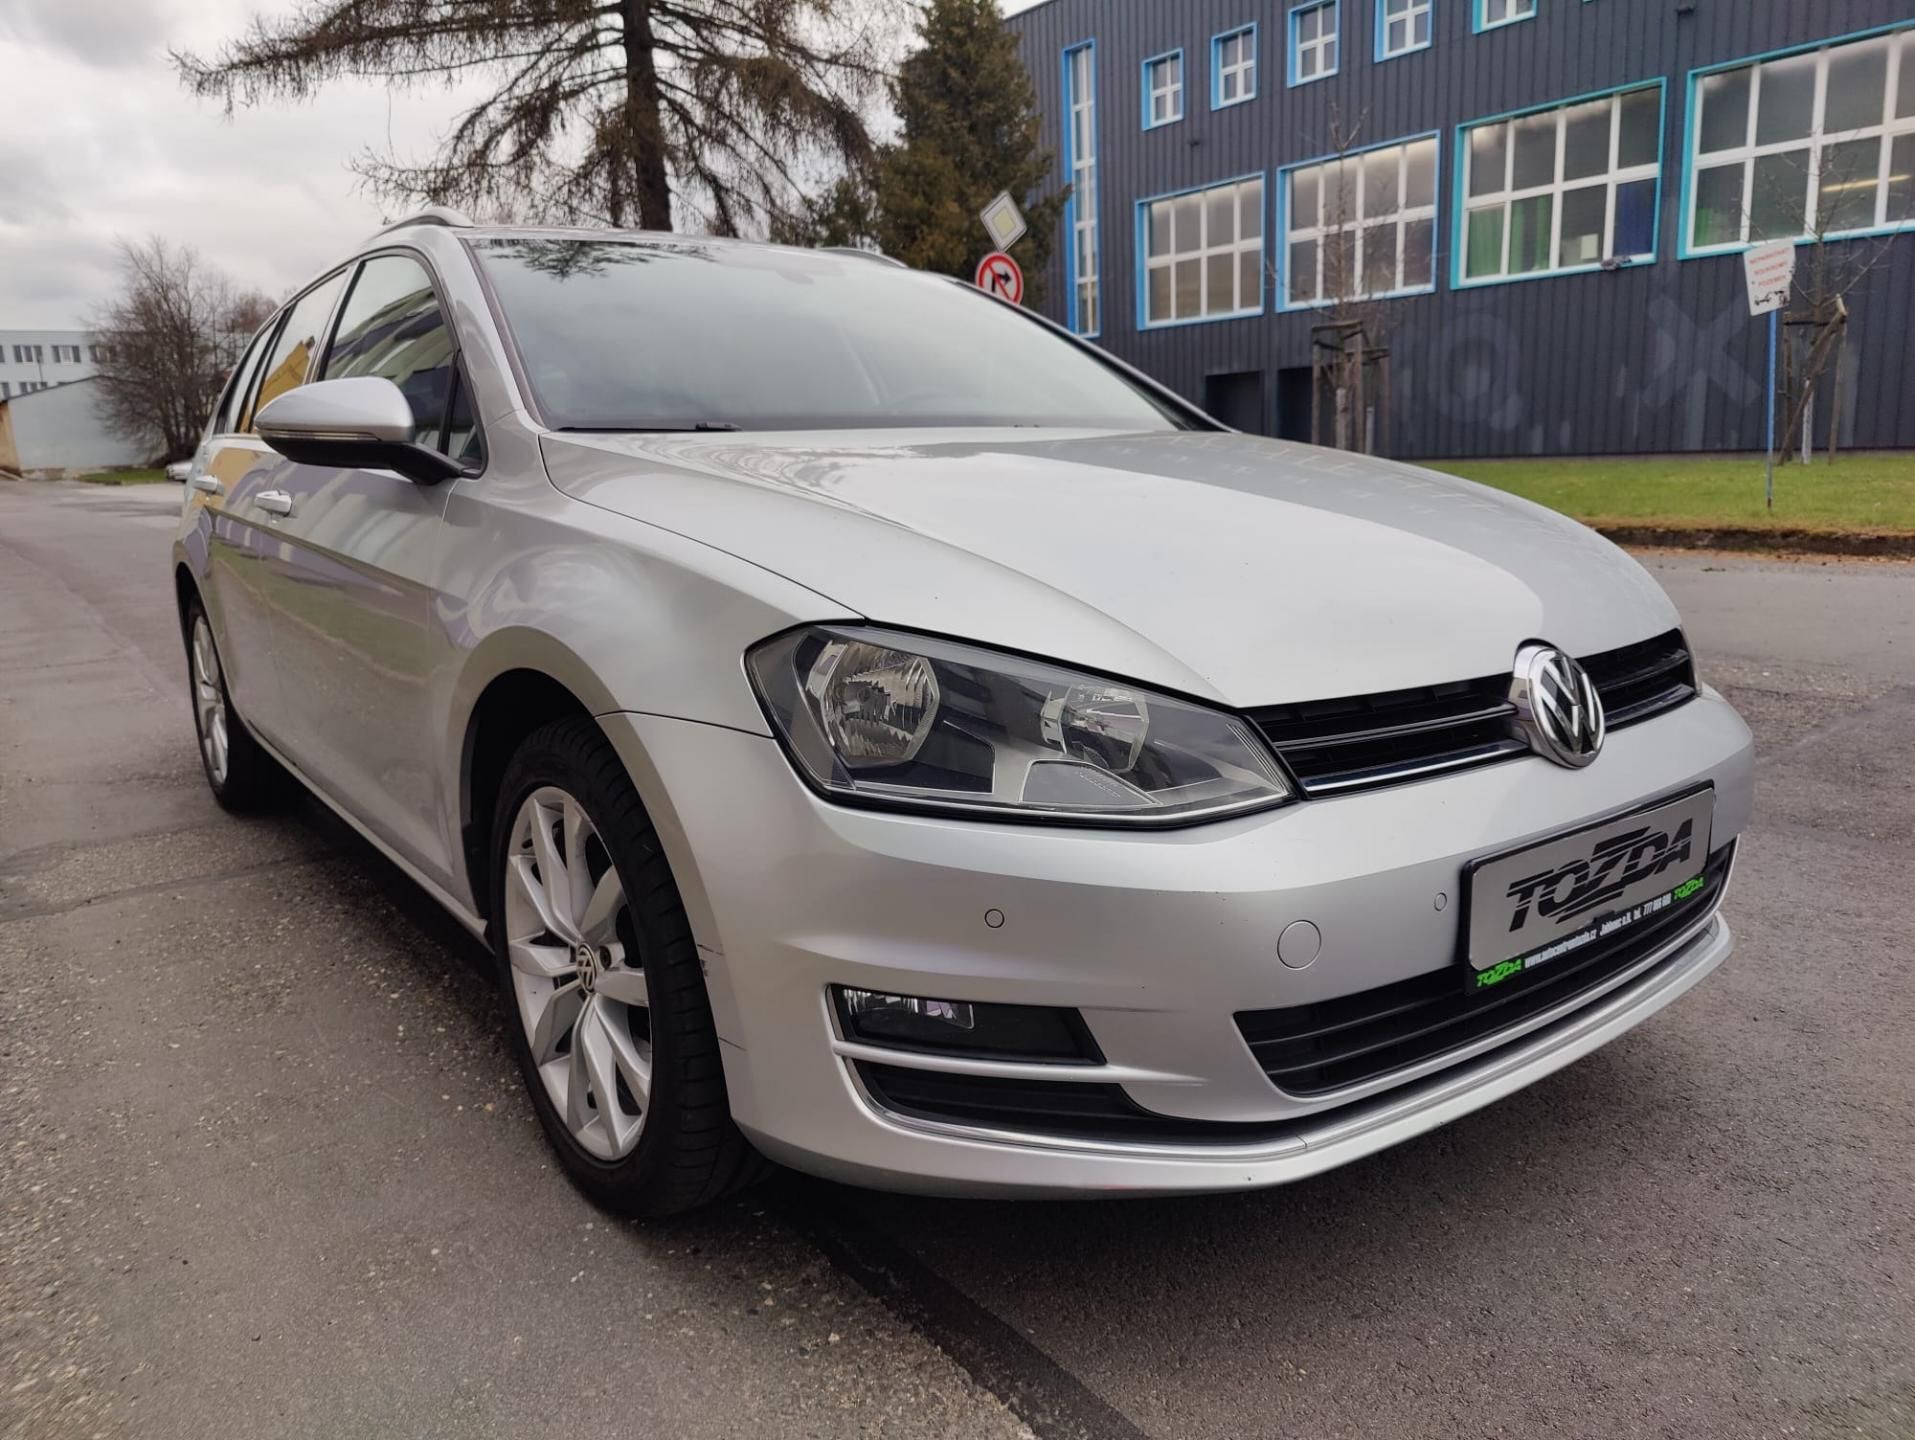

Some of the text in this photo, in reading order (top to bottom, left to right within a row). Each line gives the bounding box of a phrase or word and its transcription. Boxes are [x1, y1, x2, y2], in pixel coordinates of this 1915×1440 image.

[1507, 818, 1693, 932] TOZDA
[1476, 959, 1521, 987] TOZDA
[1674, 877, 1704, 900] TOZDA
